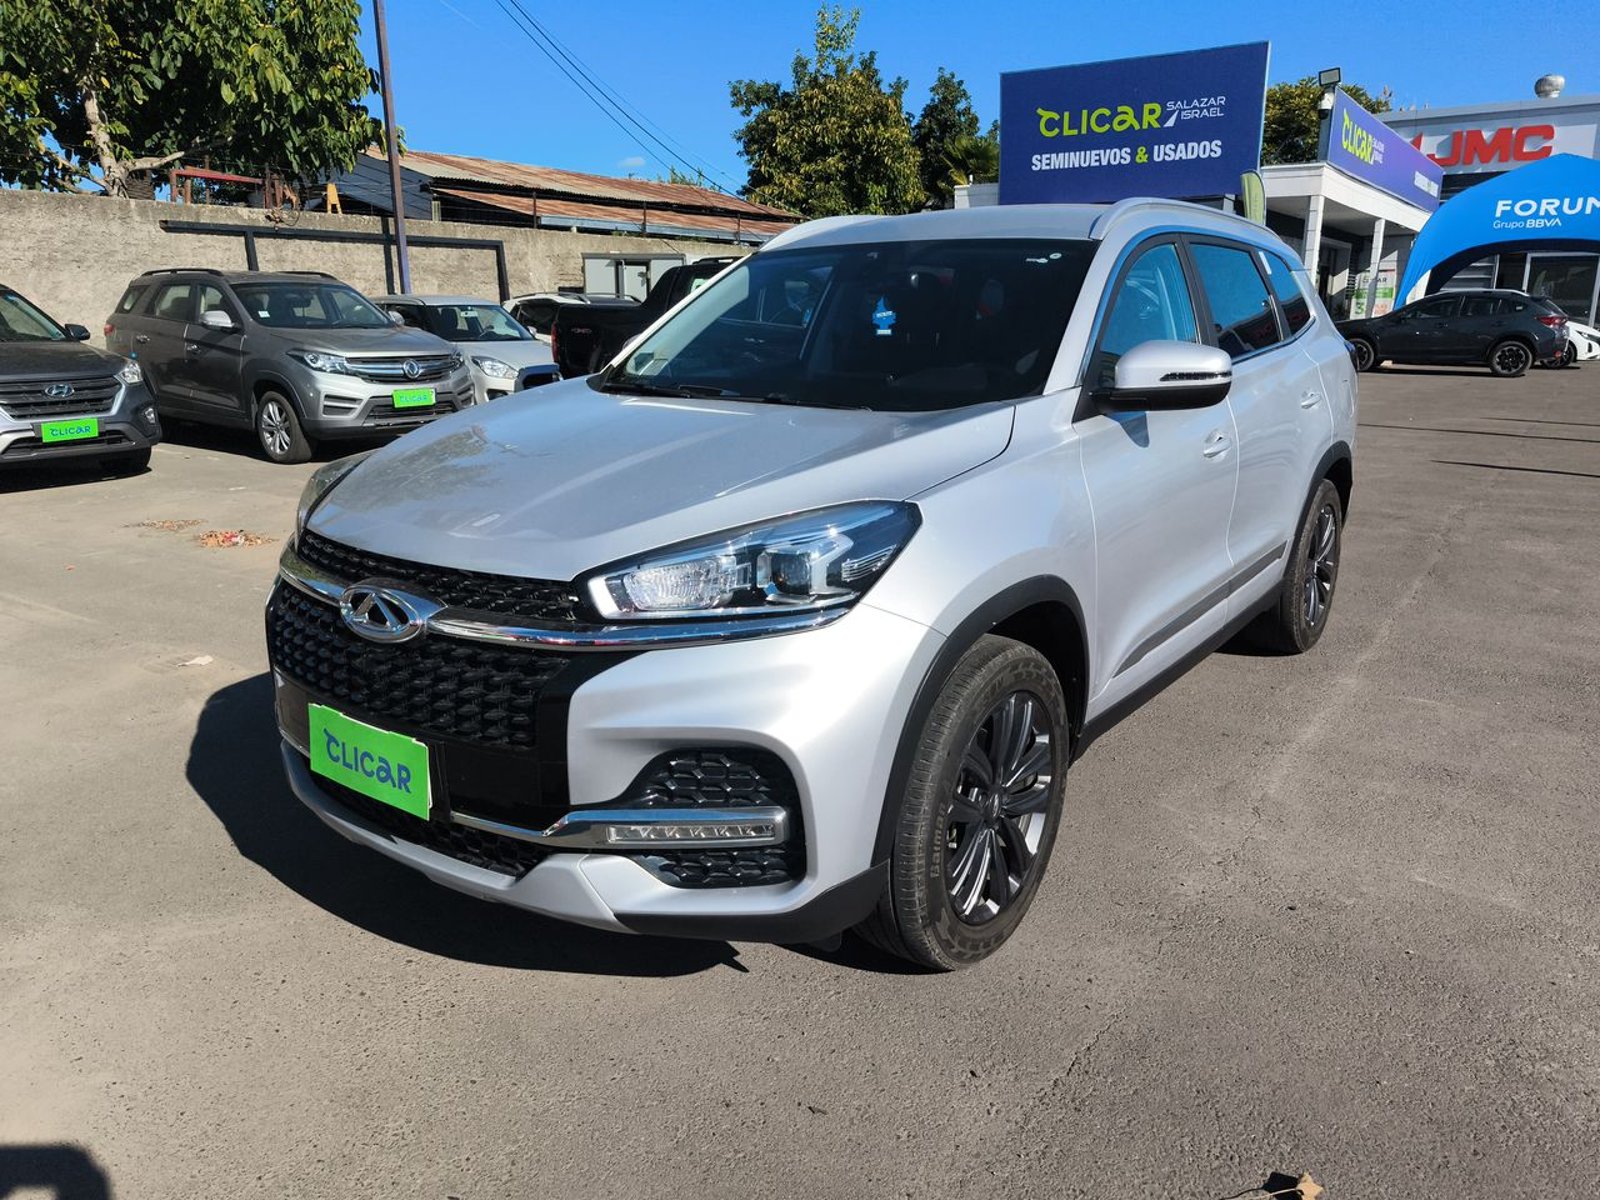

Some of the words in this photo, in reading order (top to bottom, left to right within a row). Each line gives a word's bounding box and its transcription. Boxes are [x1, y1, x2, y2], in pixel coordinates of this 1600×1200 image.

[1166, 96, 1226, 111] SALAZAR
[1180, 107, 1225, 120] ISRAEL
[1427, 124, 1555, 166] JMC
[1031, 147, 1131, 171] SEMINUEVOS
[1135, 146, 1148, 164] &
[1153, 140, 1222, 162] USADOS
[1493, 219, 1525, 230] Grupo
[1525, 217, 1562, 229] BBVA
